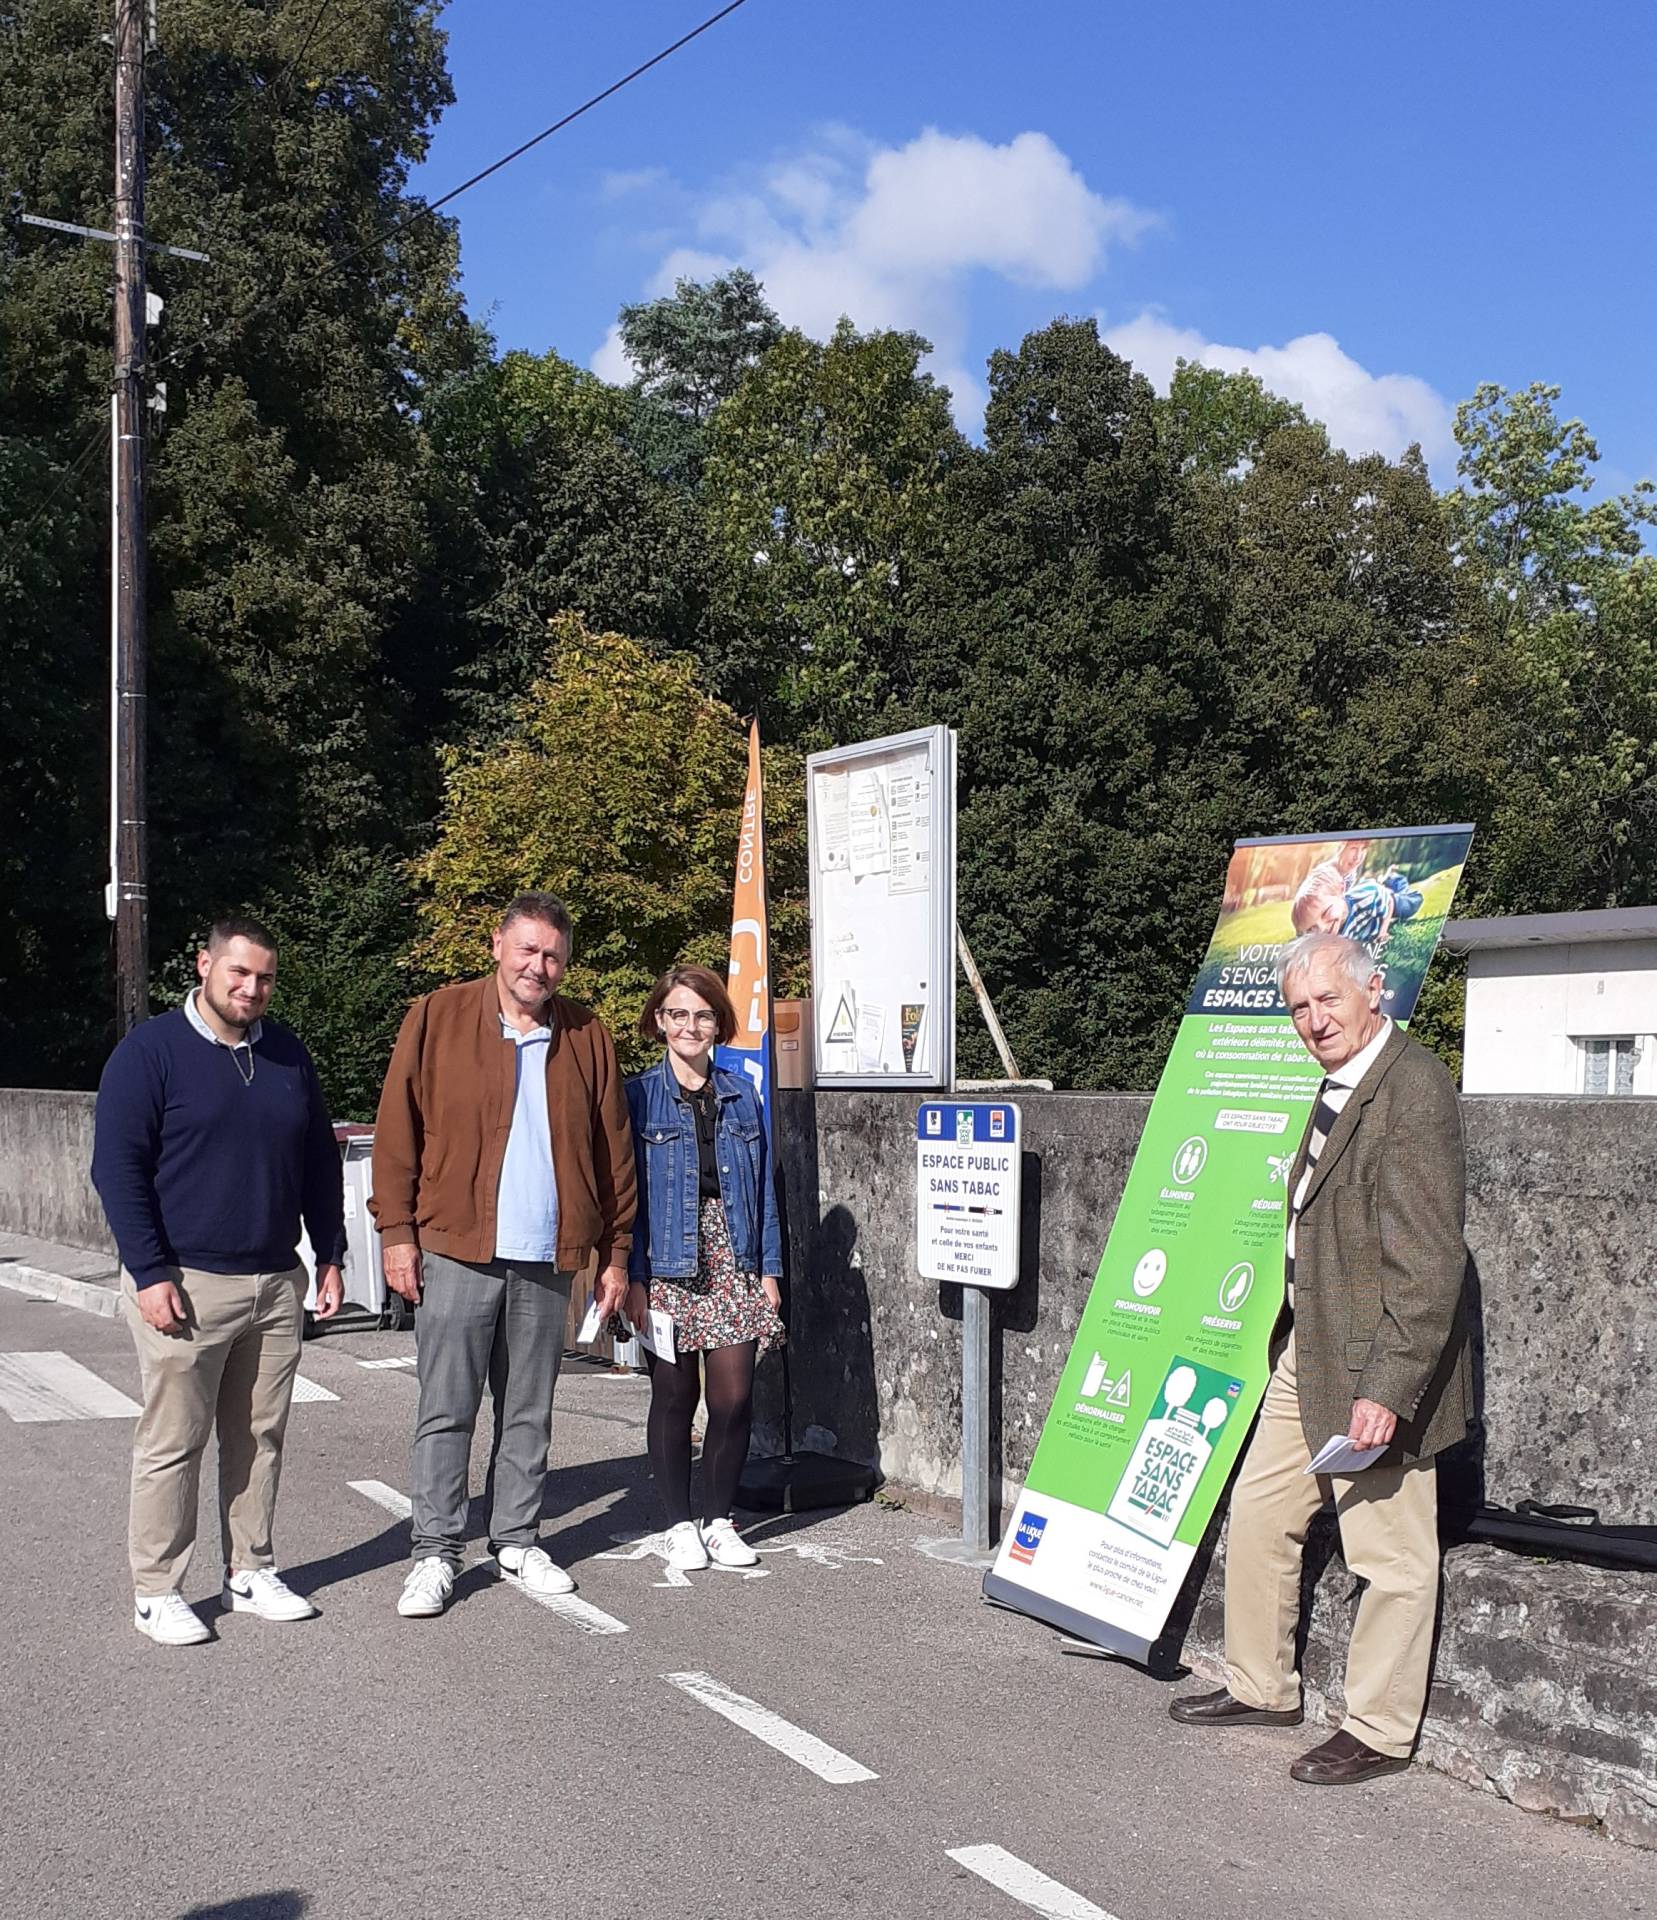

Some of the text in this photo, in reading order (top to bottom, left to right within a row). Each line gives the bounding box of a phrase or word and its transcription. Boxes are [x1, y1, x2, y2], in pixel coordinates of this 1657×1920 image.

[1202, 988, 1276, 1008] ESPACES
[1224, 1022, 1257, 1035] Espaces
[1258, 1025, 1277, 1034] sans
[1212, 1036, 1249, 1047] extérieurs
[1250, 1038, 1285, 1049] délimités
[1215, 1050, 1270, 1061] consommation
[1270, 1052, 1282, 1062] de
[922, 1154, 1009, 1172] ESPACE PUBLIC
[930, 1178, 1000, 1196] SANS TABAC
[1160, 1187, 1196, 1201] ÉLIMINER
[1251, 1198, 1284, 1210] RÉDUIRE
[940, 1226, 989, 1238] Pour votre santé
[939, 1239, 953, 1247] celle
[955, 1240, 962, 1248] de
[976, 1242, 998, 1252] enfants
[954, 1252, 974, 1261] MERCI
[937, 1262, 992, 1277] DE NE PAS FUMER
[1114, 1299, 1161, 1316] PROMOUVOIR
[1201, 1315, 1242, 1330] PRÉSERVER
[1074, 1402, 1126, 1424] DÉNORMALISER
[1144, 1436, 1198, 1474] ESPACE
[1140, 1457, 1184, 1492] SANS
[1132, 1475, 1178, 1513] TABAC
[1018, 1522, 1027, 1534] LA
